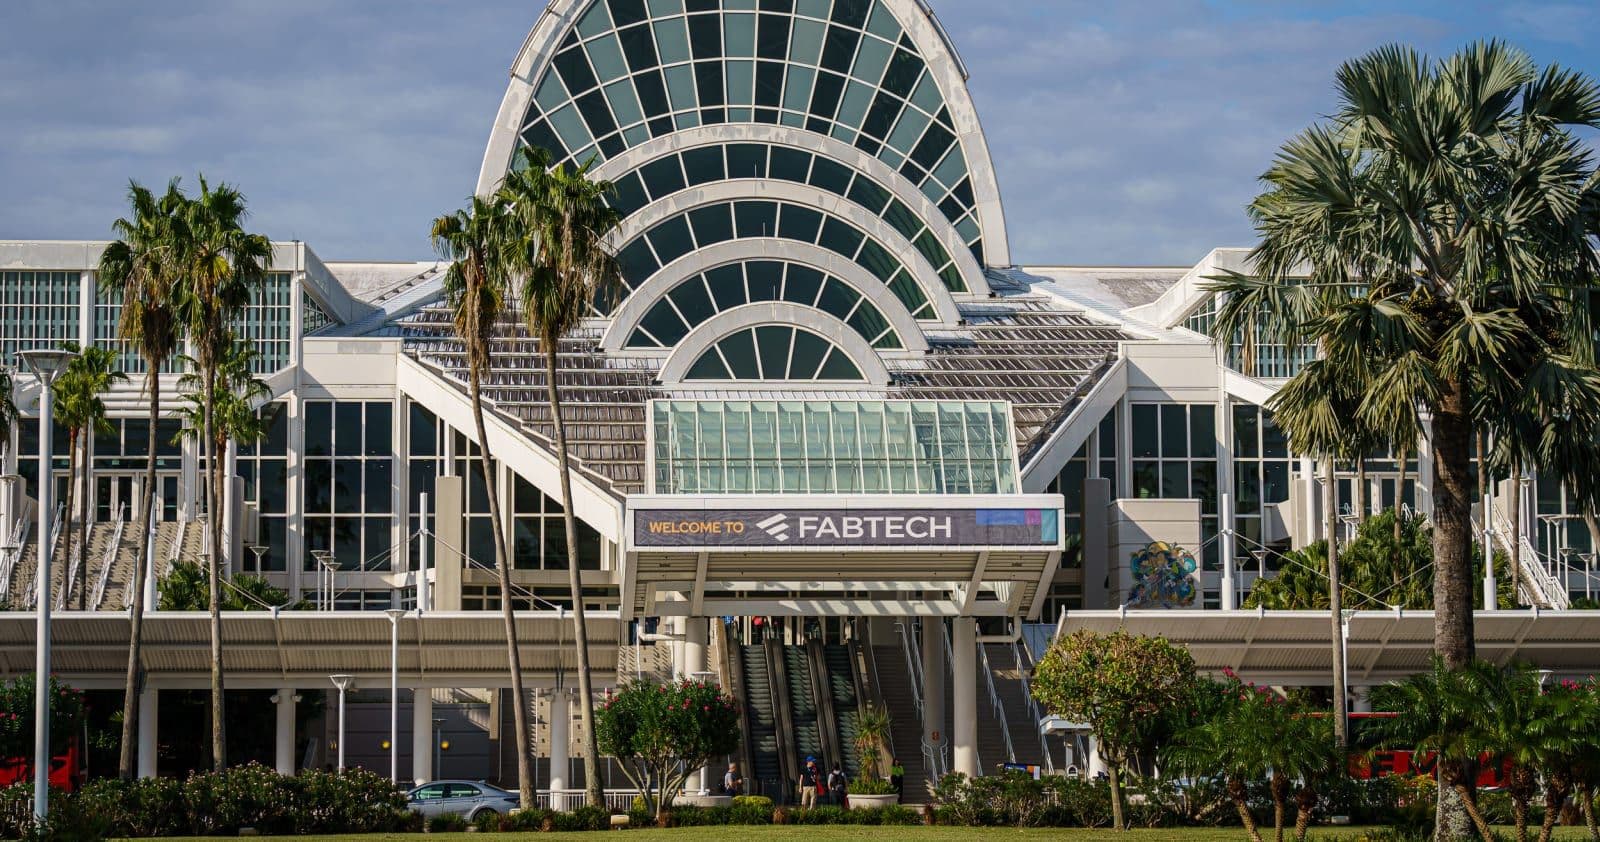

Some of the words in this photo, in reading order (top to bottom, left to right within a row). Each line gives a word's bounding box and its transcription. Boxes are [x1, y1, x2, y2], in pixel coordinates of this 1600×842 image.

[649, 521, 721, 533] WELCOME
[725, 521, 744, 533] TO
[799, 516, 952, 538] FABTECH
